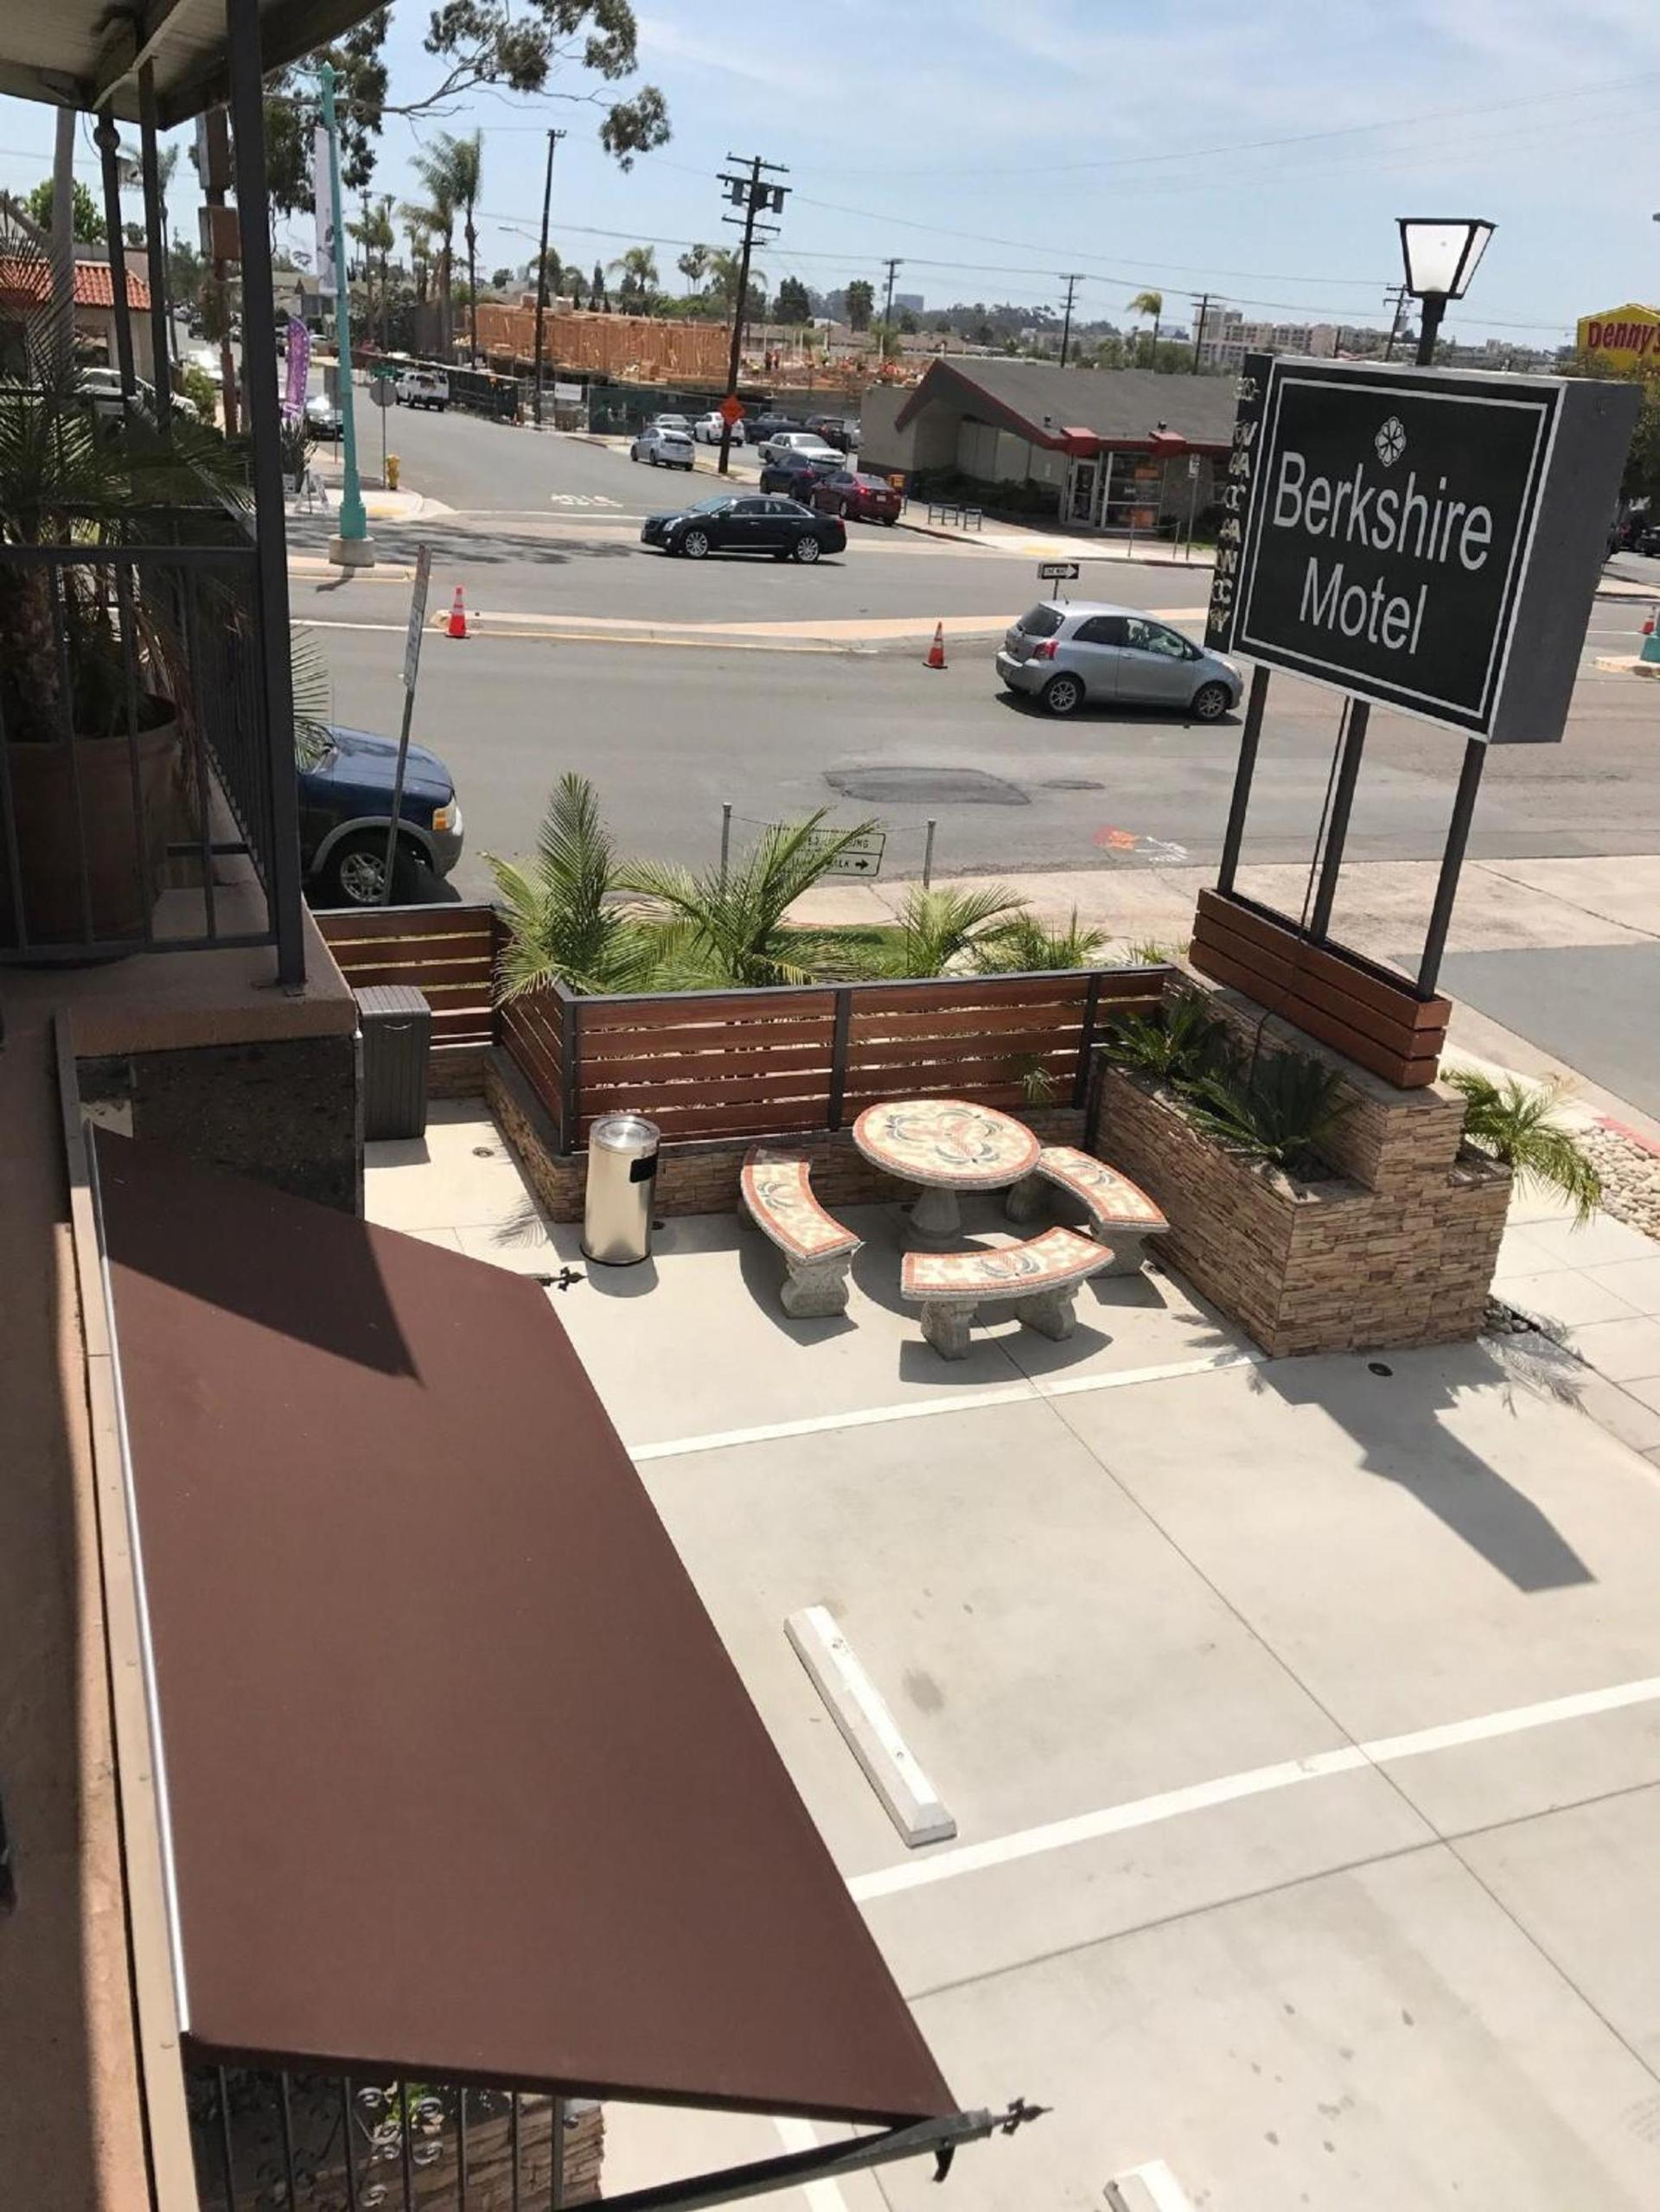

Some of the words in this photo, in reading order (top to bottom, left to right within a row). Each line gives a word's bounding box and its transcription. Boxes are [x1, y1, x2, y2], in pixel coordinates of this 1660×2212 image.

[1587, 321, 1660, 354] Denny
[1273, 450, 1493, 571] Berkshire
[1299, 556, 1428, 655] Motel
